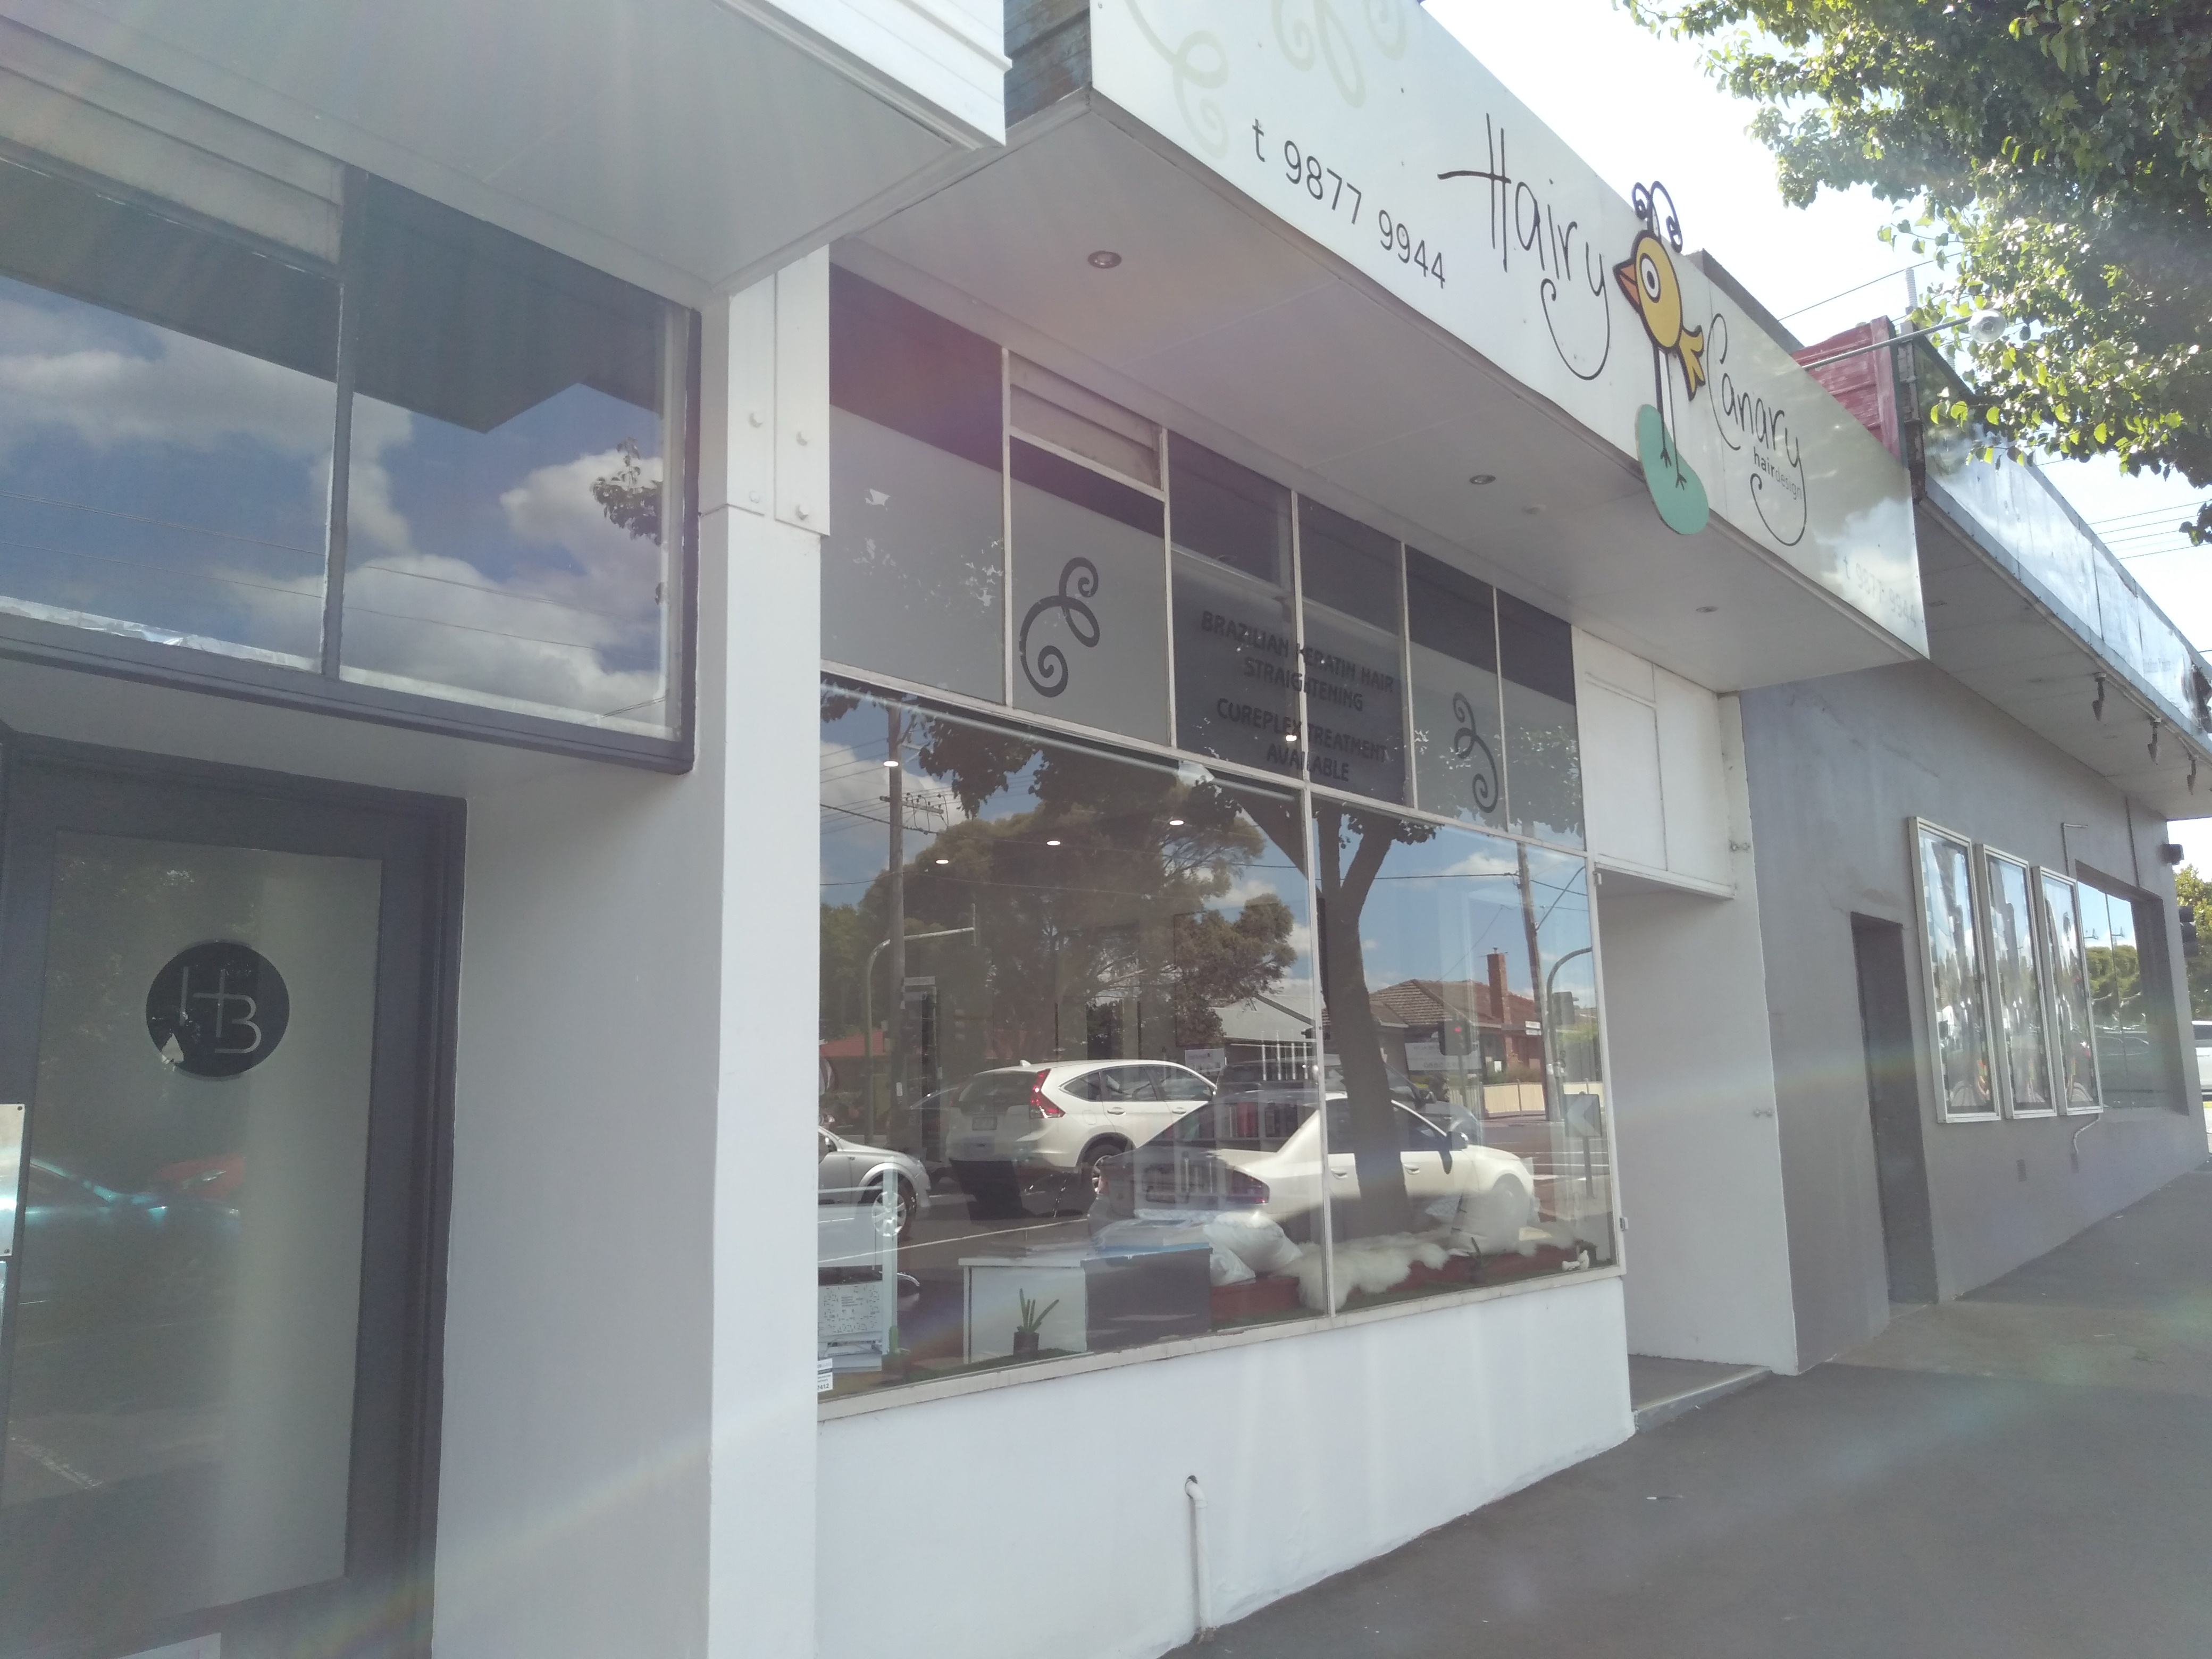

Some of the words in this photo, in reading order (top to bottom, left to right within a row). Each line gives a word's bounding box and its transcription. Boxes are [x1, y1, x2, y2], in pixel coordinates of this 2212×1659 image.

[1252, 118, 1266, 162] t
[1284, 140, 1362, 225] 9877
[1378, 209, 1446, 289] 9944
[1437, 112, 1610, 381] Hairy
[1706, 313, 1807, 547] Canary
[1201, 610, 1289, 658] BRAZILIAN
[1361, 666, 1394, 692] HAIR
[1308, 723, 1387, 763] TREATMENT
